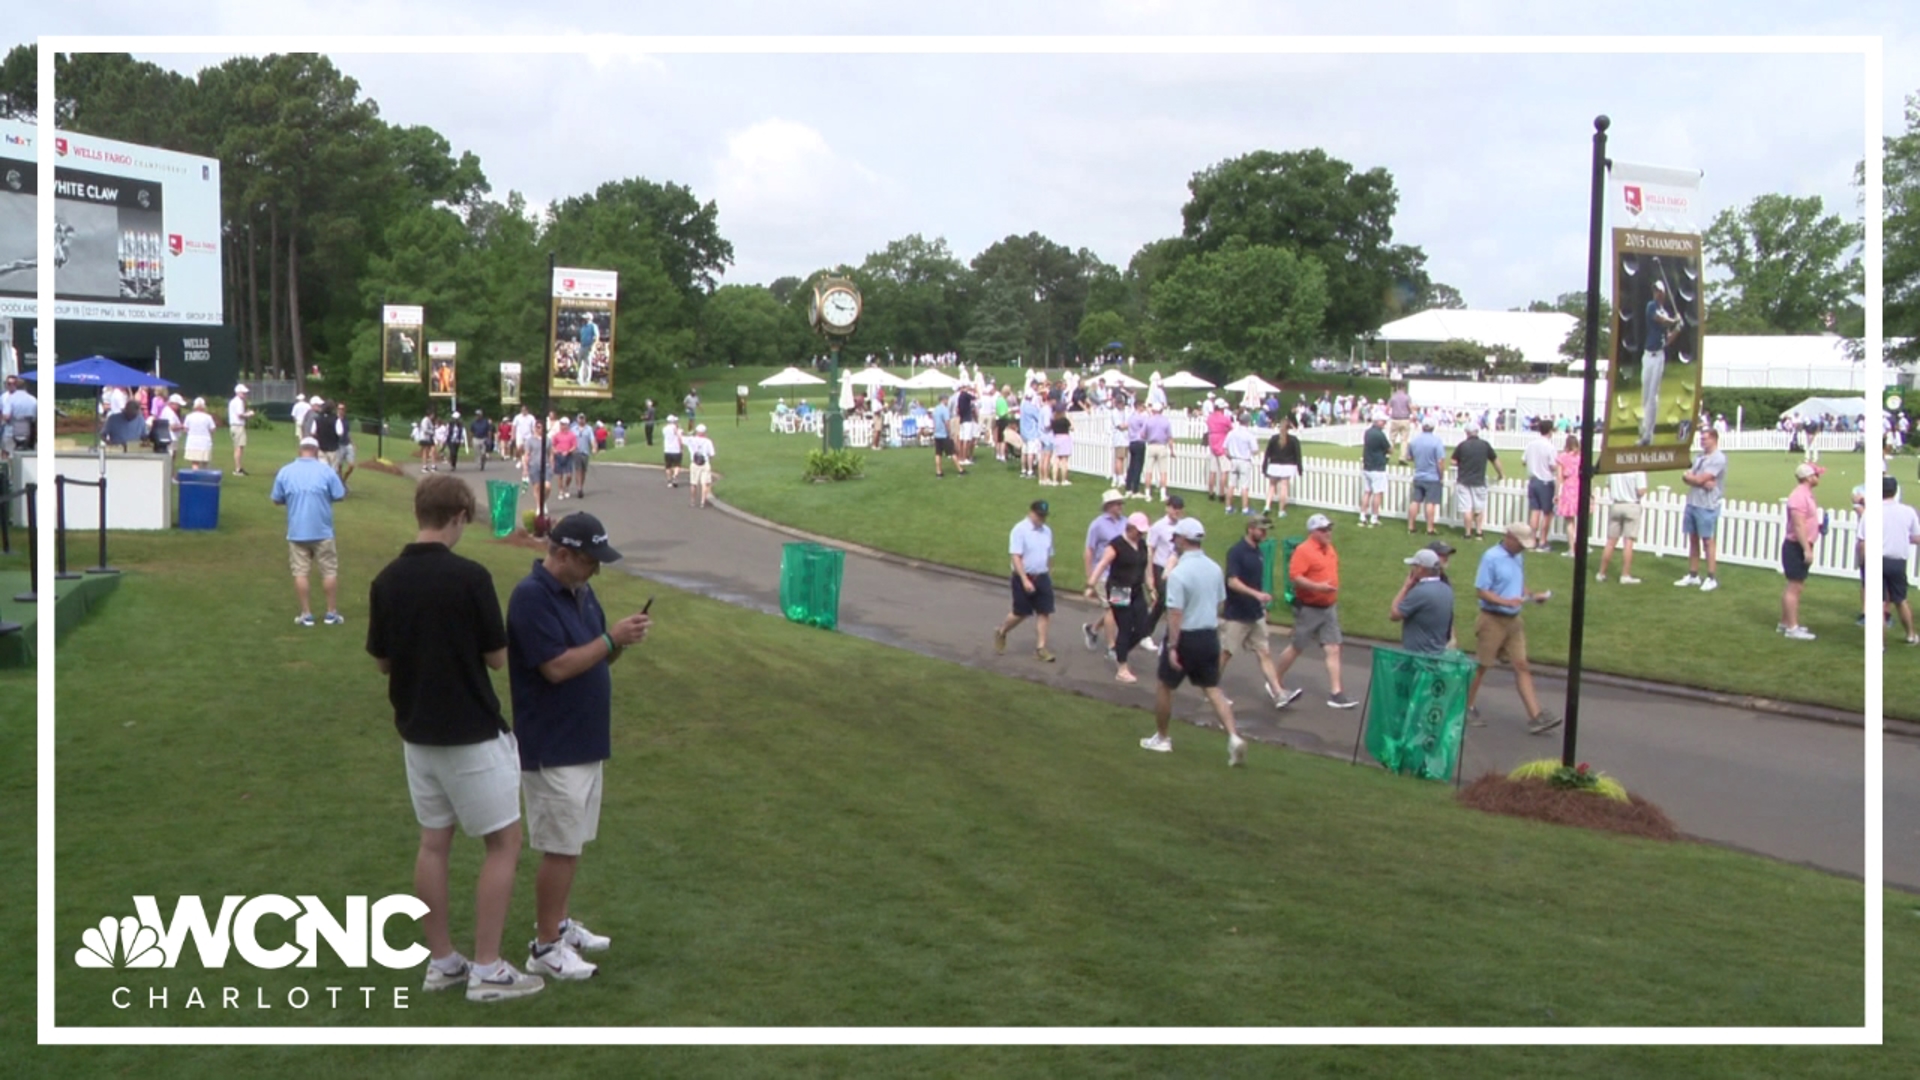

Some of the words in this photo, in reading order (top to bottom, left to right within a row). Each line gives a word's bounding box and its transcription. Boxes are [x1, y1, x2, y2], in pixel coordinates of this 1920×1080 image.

[73, 146, 103, 161] WELLS
[104, 153, 133, 166] FARGO
[86, 184, 119, 201] CLAW
[1625, 232, 1645, 249] 2015
[1646, 236, 1693, 251] CHAMPION
[182, 337, 209, 349] WELLS
[183, 349, 211, 361] FARGO
[1616, 452, 1638, 464] RORY
[1640, 451, 1675, 463] McILROY
